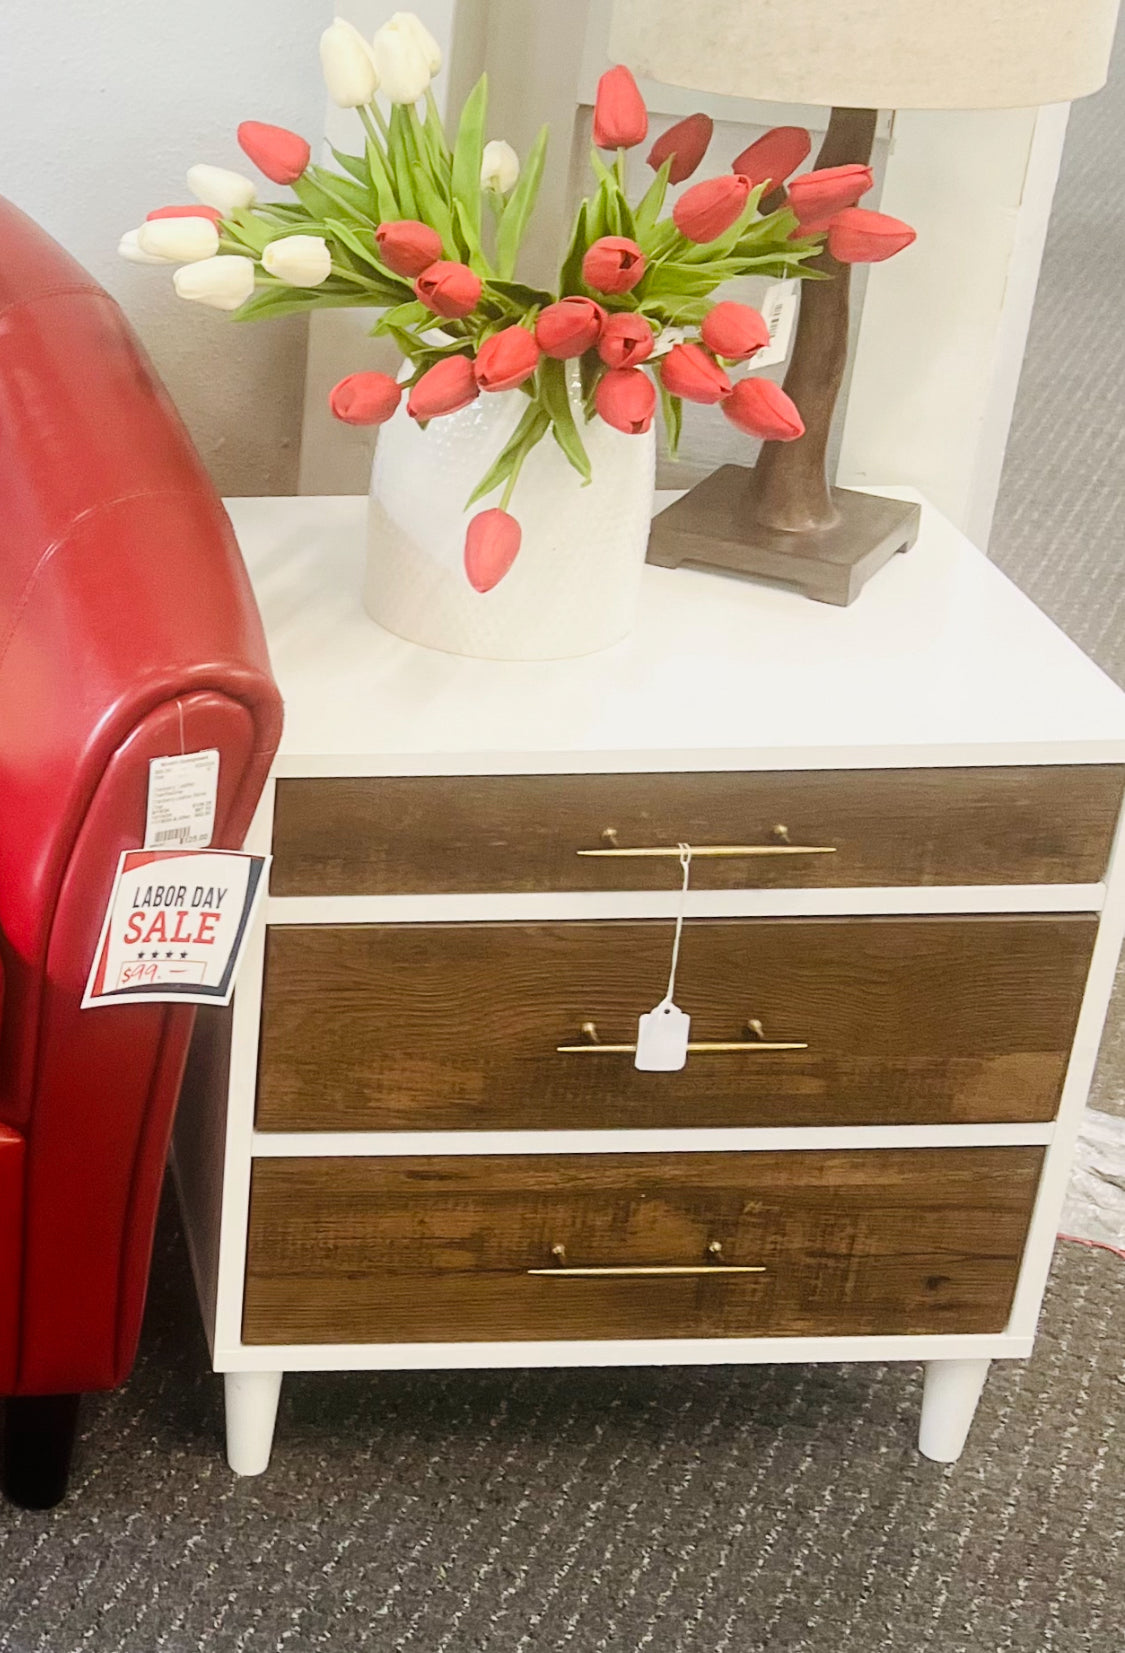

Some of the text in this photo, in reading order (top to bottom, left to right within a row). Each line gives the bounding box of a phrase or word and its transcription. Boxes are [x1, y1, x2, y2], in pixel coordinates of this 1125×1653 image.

[133, 886, 228, 909] LABOR DAY
[123, 910, 221, 945] SALE
